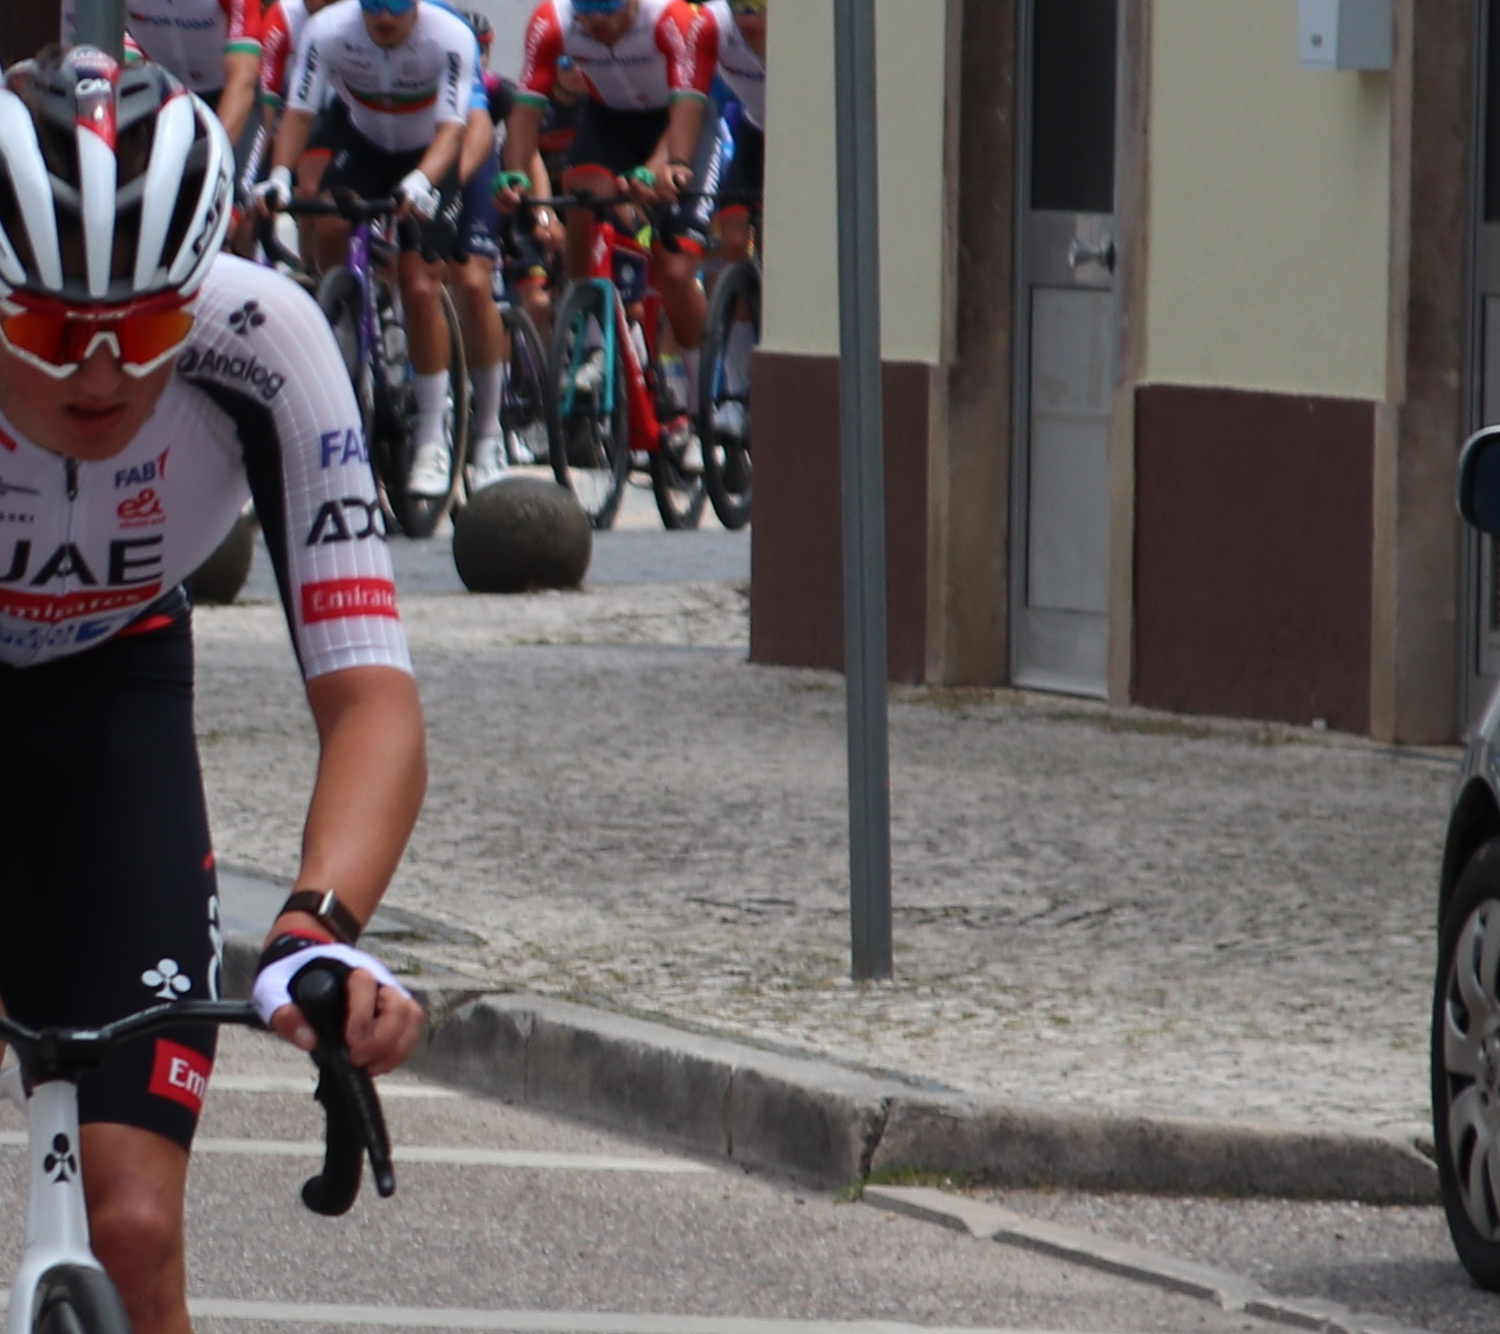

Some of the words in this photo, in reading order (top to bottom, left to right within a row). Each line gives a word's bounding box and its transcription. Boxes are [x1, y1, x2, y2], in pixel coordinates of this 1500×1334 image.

[199, 348, 285, 400] Analog
[115, 462, 156, 489] FAB
[312, 584, 395, 612] Emirate
